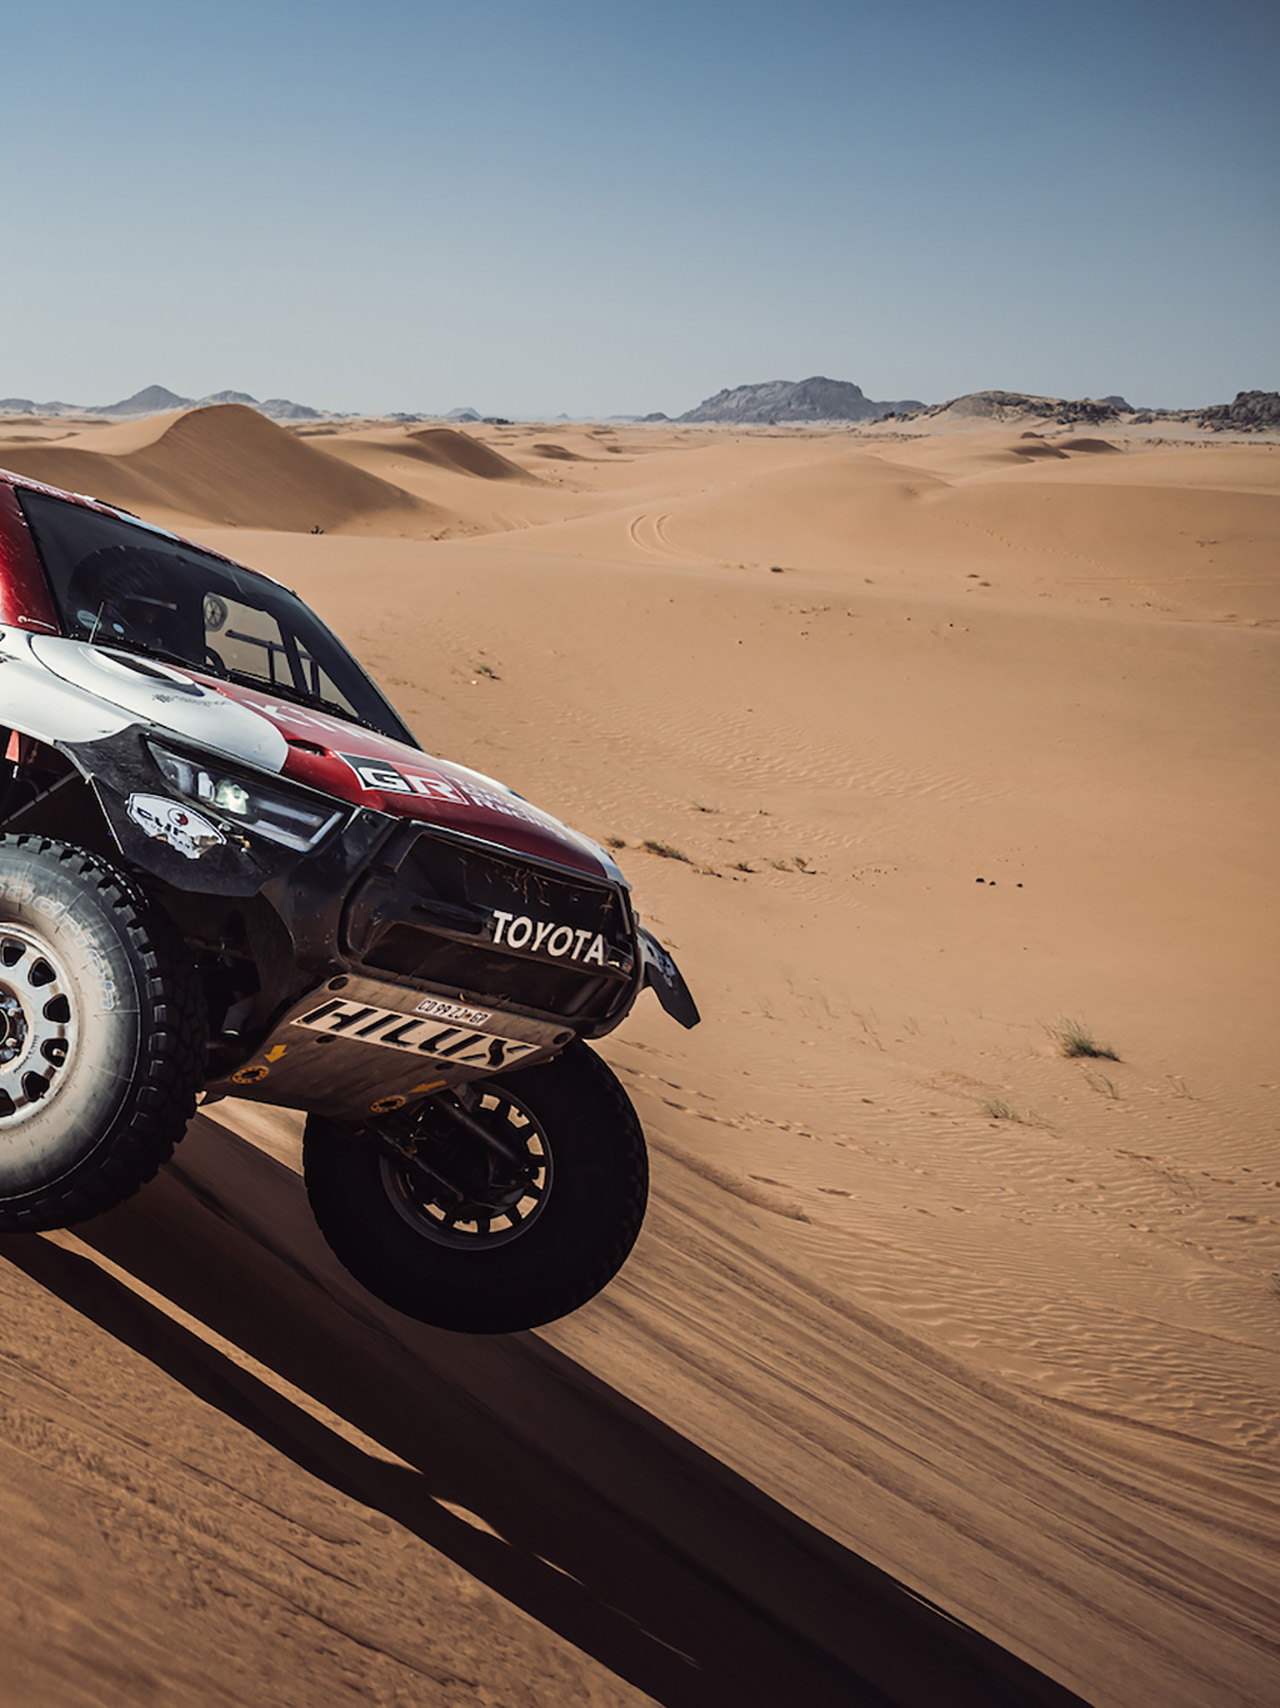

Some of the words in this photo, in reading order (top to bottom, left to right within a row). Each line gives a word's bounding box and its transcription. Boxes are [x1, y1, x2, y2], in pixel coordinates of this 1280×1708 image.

[356, 766, 460, 800] GR
[492, 909, 606, 967] TOYOTA
[433, 1003, 452, 1016] 99
[298, 1000, 535, 1068] HILUX
